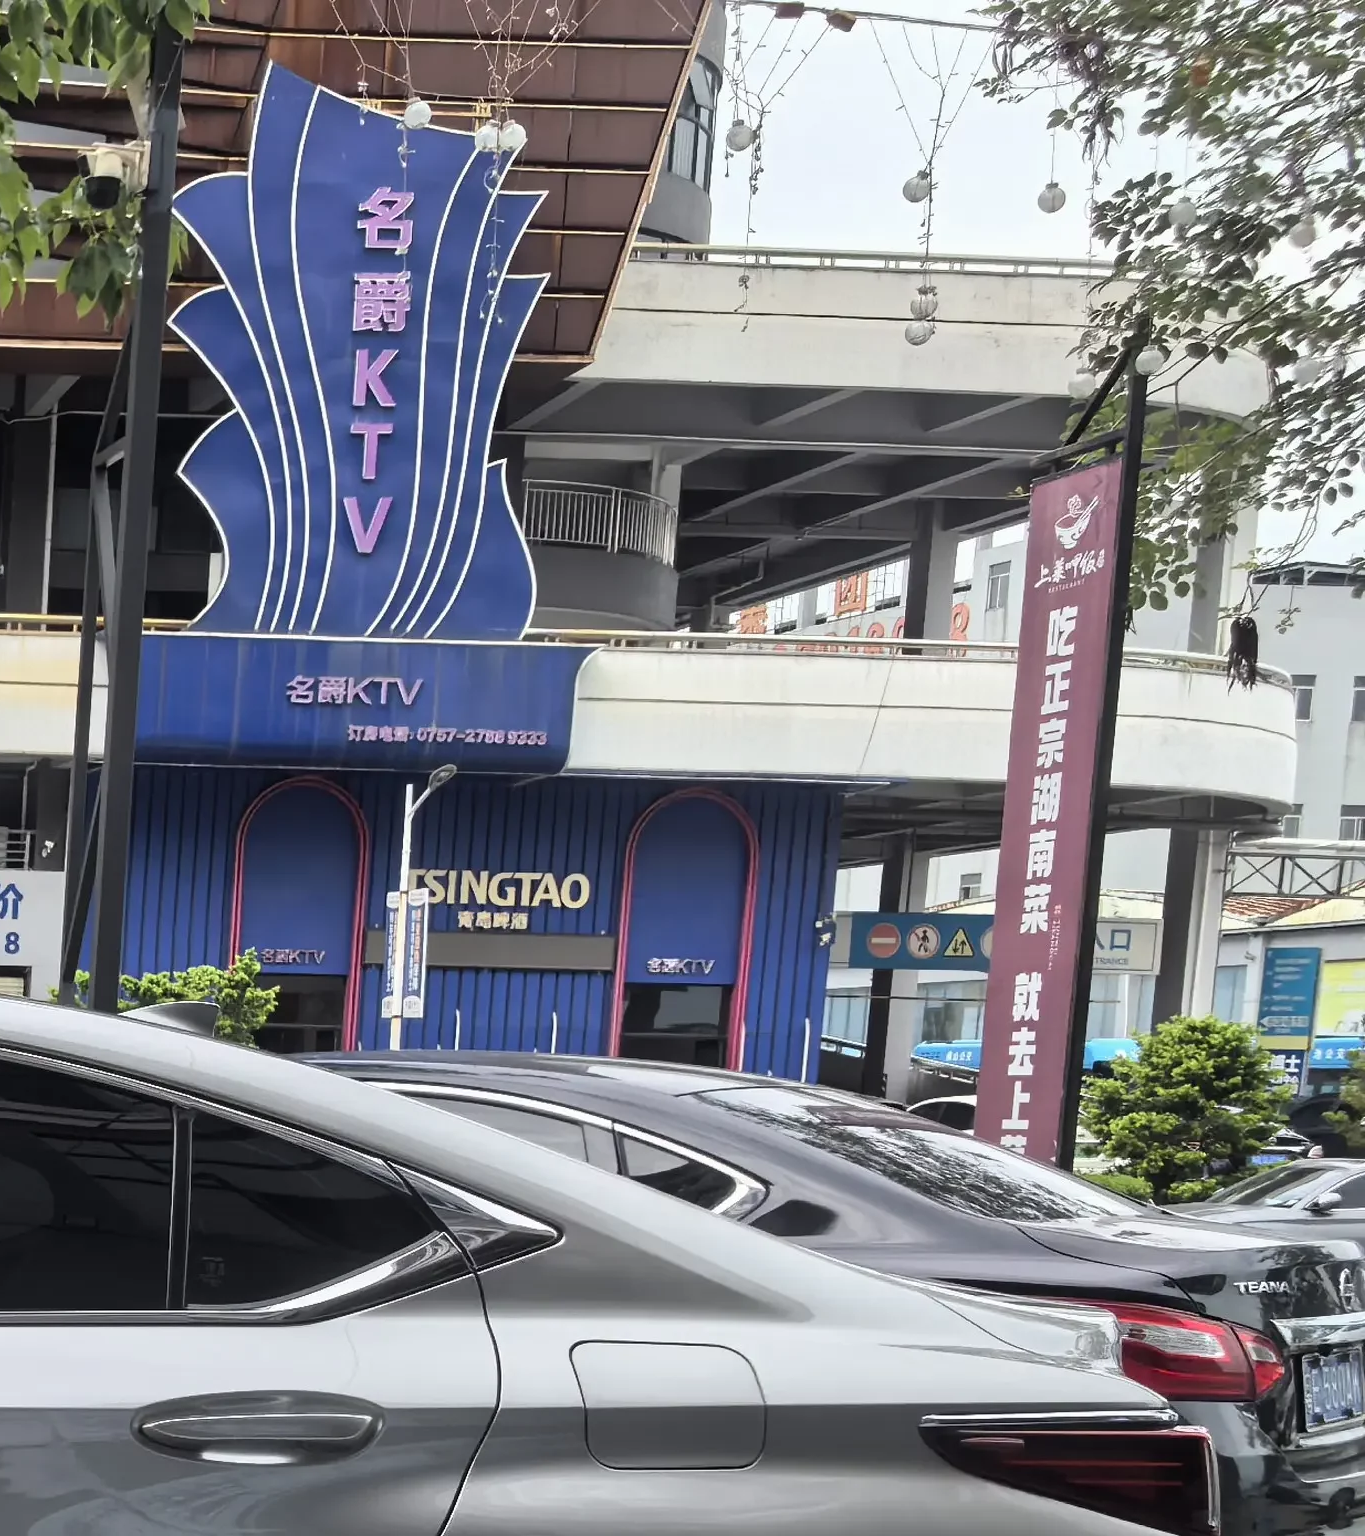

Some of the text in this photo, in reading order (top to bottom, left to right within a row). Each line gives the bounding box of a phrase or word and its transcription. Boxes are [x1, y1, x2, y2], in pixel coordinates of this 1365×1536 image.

[343, 187, 414, 553] 名爵KTV
[286, 675, 424, 706] 名爵KTV
[1020, 605, 1078, 934] 吃正宗湖南菜
[409, 868, 590, 909] TSINGTAO
[1233, 1281, 1291, 1294] TEANA
